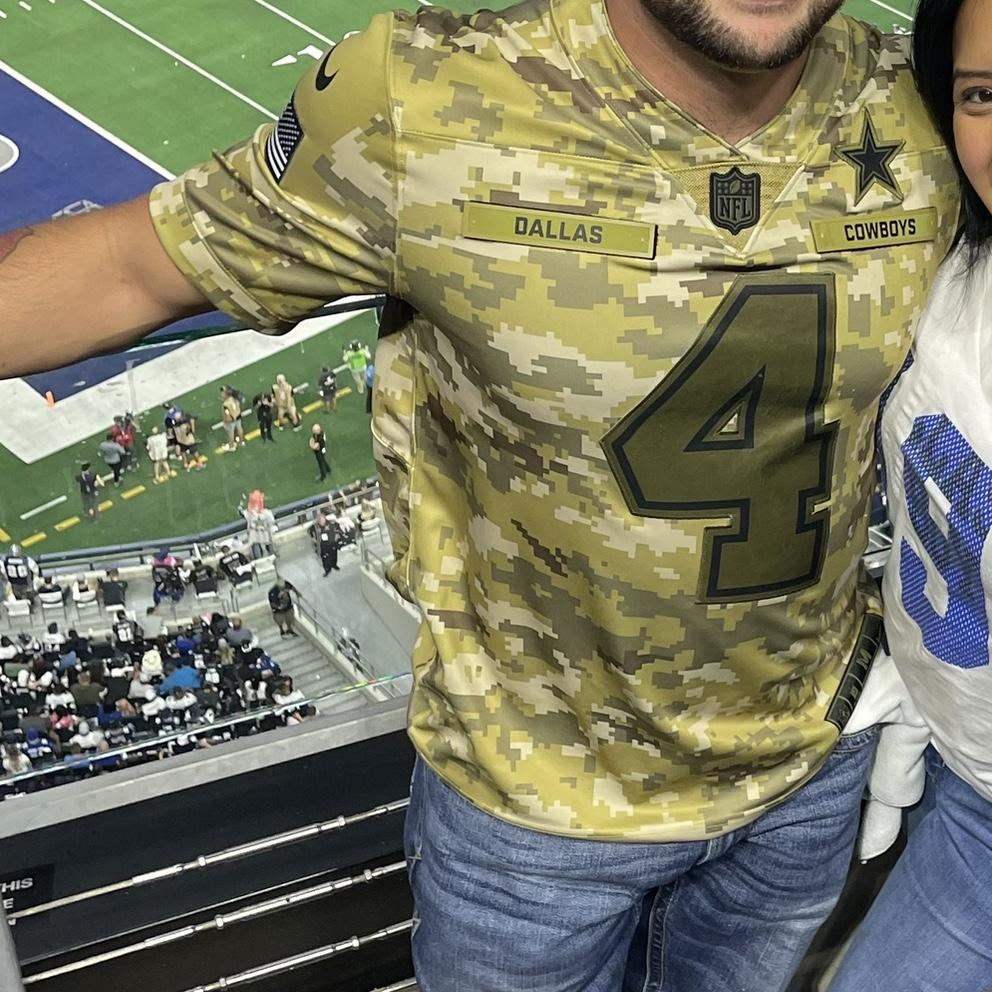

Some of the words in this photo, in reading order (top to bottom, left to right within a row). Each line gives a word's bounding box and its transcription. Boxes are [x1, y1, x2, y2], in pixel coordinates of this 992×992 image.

[719, 195, 750, 218] NFL
[514, 216, 603, 244] DALLAS
[844, 218, 916, 241] COWBOYS
[600, 272, 839, 605] 4
[0, 877, 33, 892] HIS
